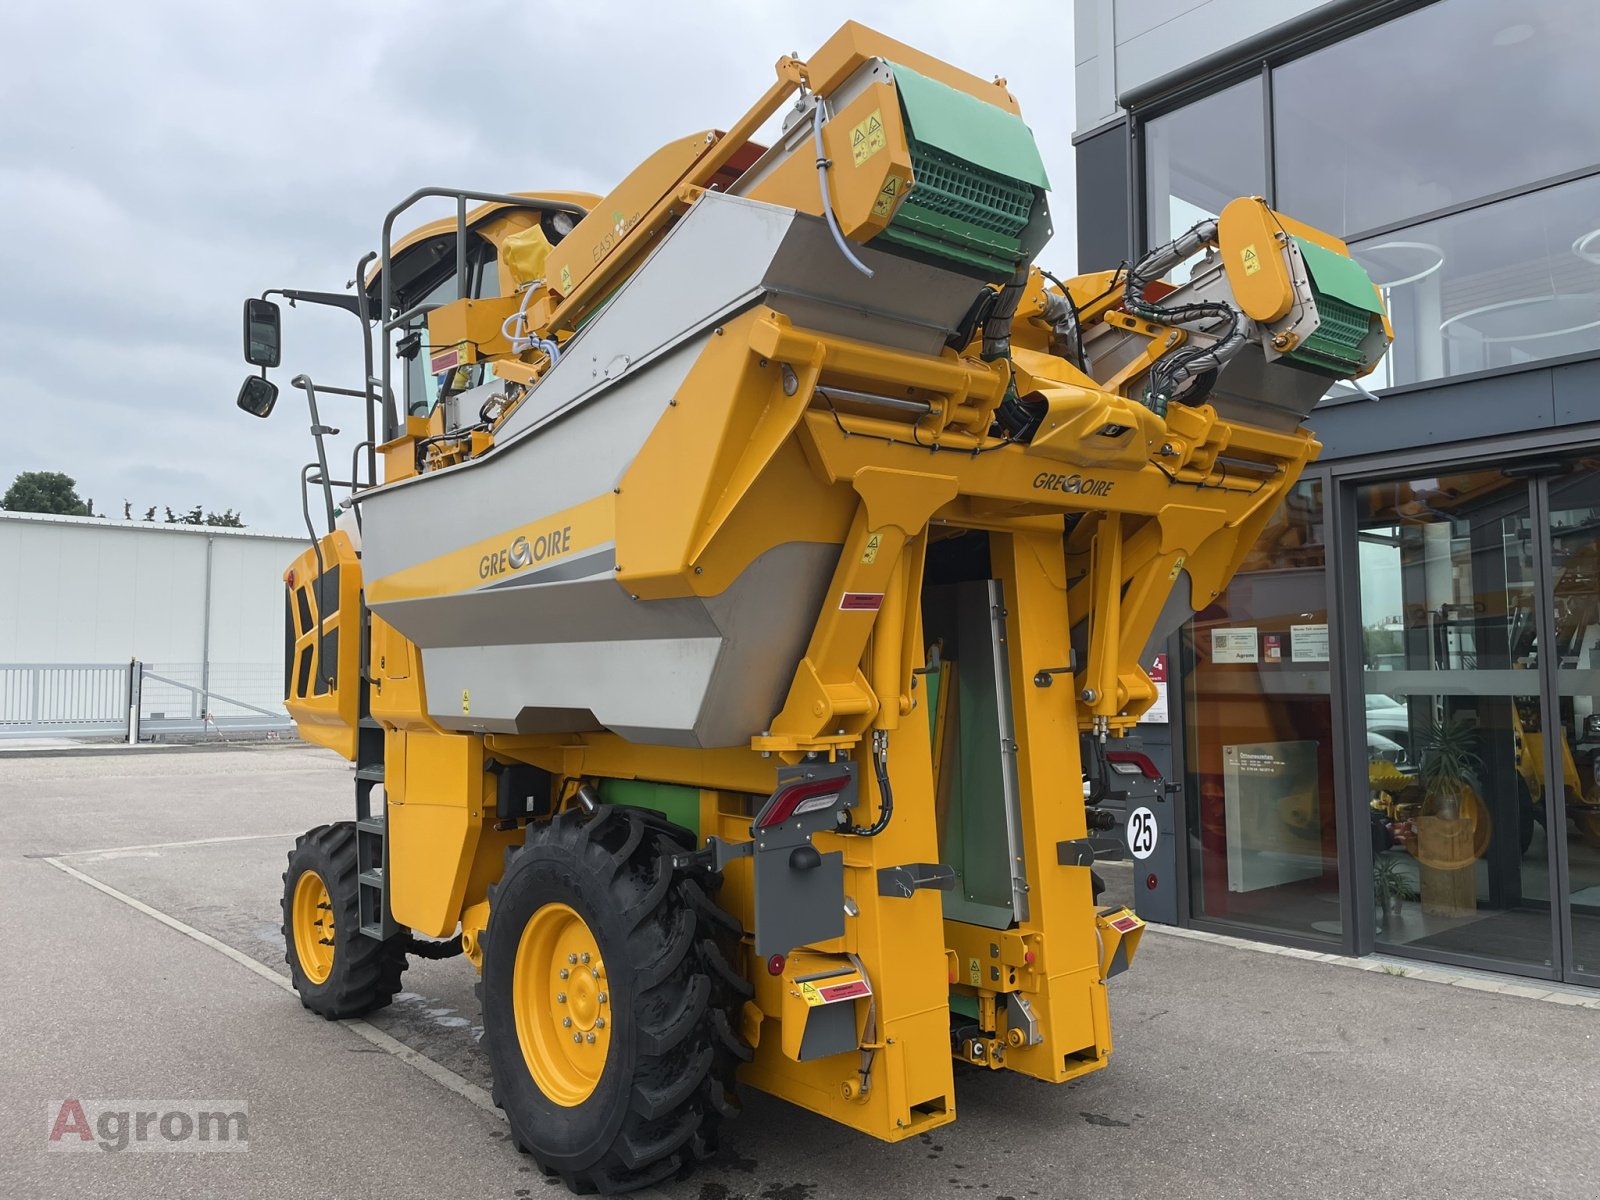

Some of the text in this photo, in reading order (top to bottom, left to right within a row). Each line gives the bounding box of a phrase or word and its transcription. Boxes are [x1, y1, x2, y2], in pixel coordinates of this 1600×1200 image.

[592, 227, 616, 263] EASY
[1032, 472, 1115, 497] GREGOIRE
[479, 526, 571, 580] GREGOIRE
[1133, 813, 1153, 853] 25
